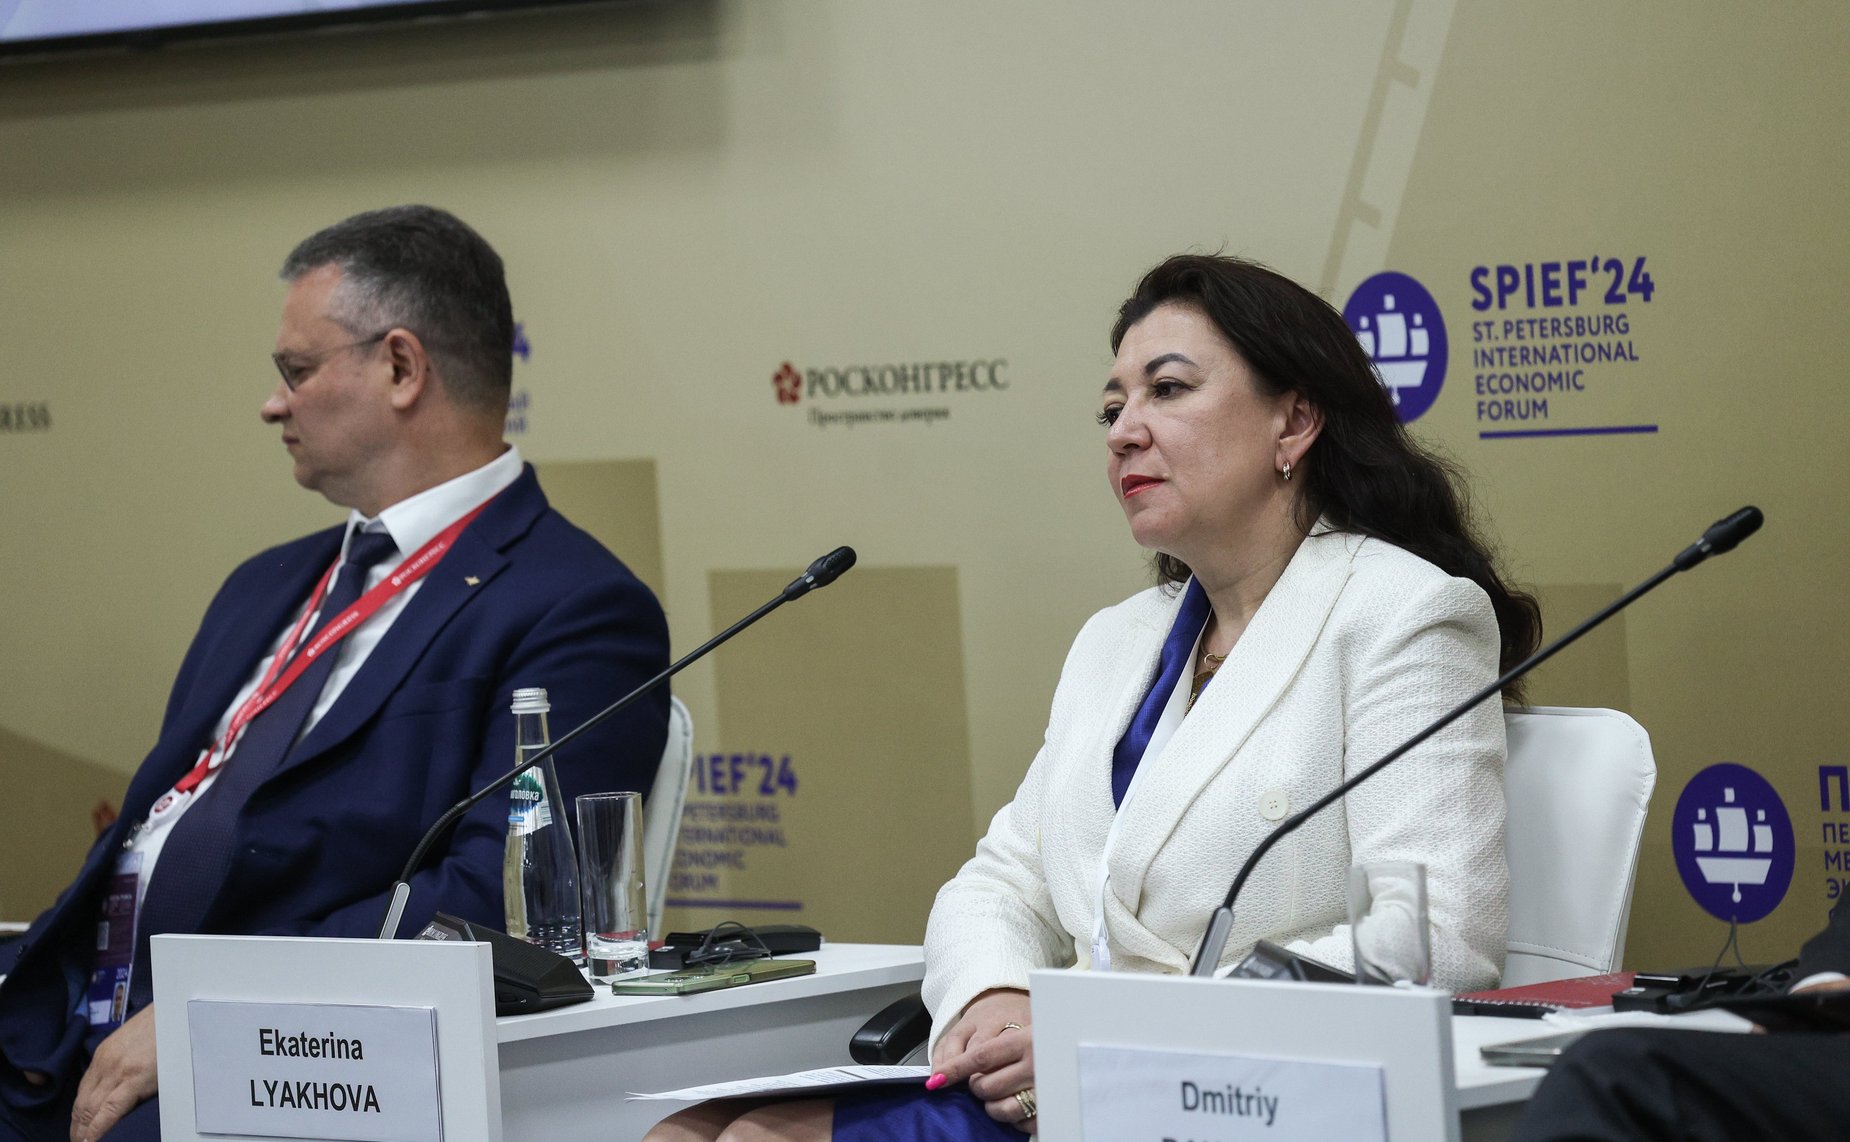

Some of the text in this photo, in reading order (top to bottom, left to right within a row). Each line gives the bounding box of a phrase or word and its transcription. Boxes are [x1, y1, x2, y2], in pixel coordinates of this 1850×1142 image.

[1470, 255, 1655, 312] SPIEF'24
[1473, 313, 1631, 342] ST. PETERSBURG
[1474, 341, 1639, 368] INTERNATIONAL
[806, 358, 1010, 398] РОСКОНГРЕСС
[1475, 370, 1585, 395] ECONOMIC
[1477, 399, 1549, 421] FORUM
[692, 754, 798, 797] IEF'24
[259, 1028, 364, 1061] Ekaterina
[250, 1079, 381, 1113] LYAKHOVA
[1181, 1080, 1279, 1127] Dmitriy
